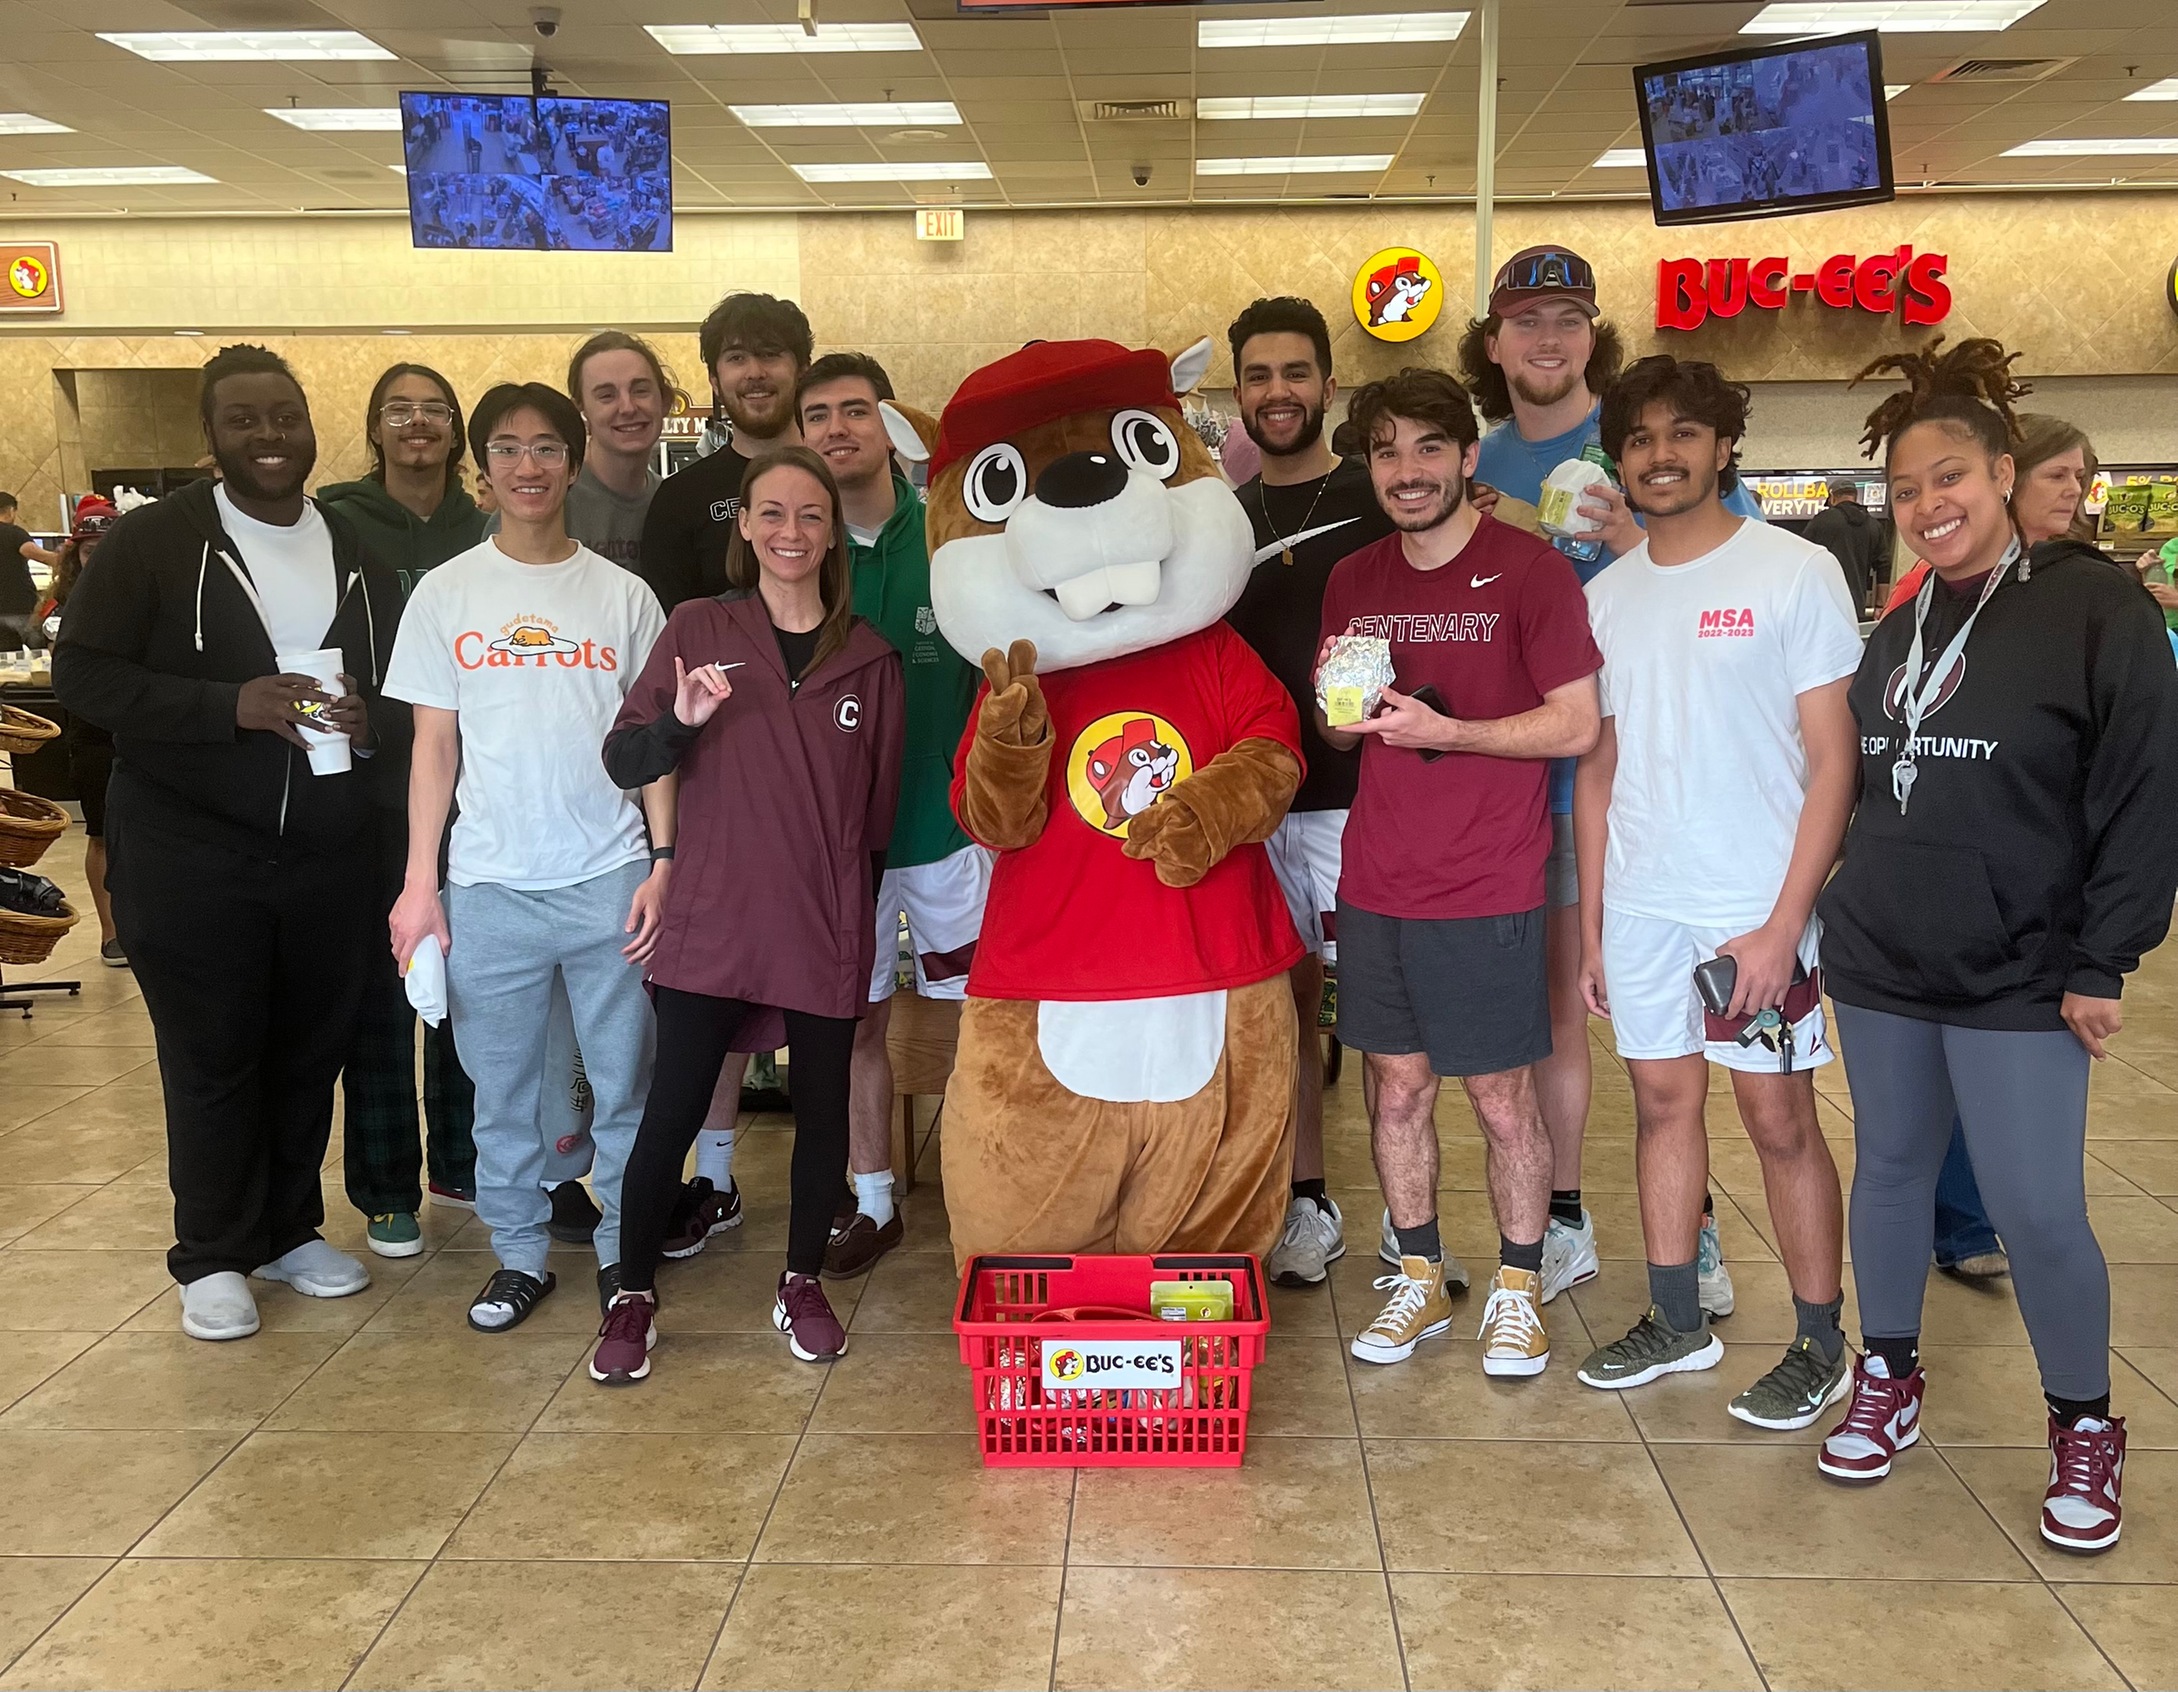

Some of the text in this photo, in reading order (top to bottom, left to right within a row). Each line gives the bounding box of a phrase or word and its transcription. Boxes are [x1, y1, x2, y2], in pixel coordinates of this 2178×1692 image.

[925, 211, 956, 237] EXIT
[1655, 243, 1953, 331] BUC-EE'S
[1757, 481, 1830, 499] ROLLBA
[500, 612, 560, 636] gudetama
[1699, 608, 1755, 629] MSA
[1697, 628, 1755, 638] 2022-2023
[839, 700, 860, 728] C
[1868, 736, 1999, 761] OPRTUNITY
[1085, 1353, 1175, 1374] BUC-EE'S
